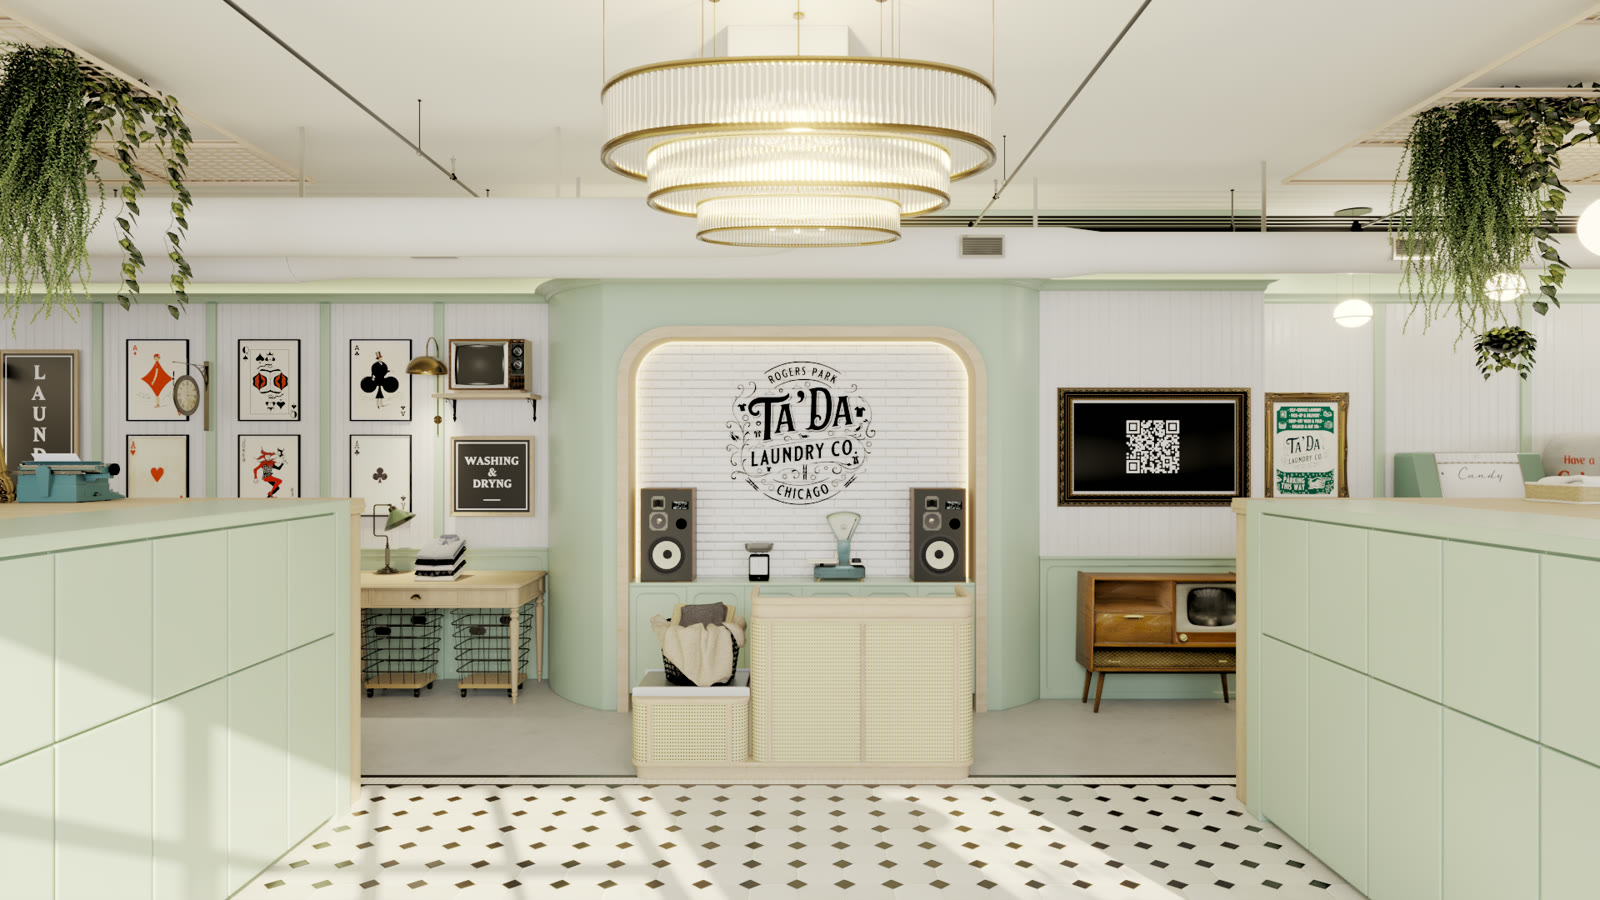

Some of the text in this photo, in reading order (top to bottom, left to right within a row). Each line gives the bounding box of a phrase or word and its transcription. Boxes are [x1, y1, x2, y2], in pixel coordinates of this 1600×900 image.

[768, 366, 838, 385] ROGERS PARK
[748, 386, 853, 441] TA'DA
[750, 439, 858, 467] LAUNDRY CO.
[1288, 455, 1312, 464] LAUNDRY
[1563, 454, 1595, 465] Have a
[464, 456, 520, 466] WASHING
[487, 467, 497, 477] &
[1457, 466, 1504, 483] Candy
[472, 479, 512, 489] DRYNG
[776, 483, 830, 500] CHICAGO
